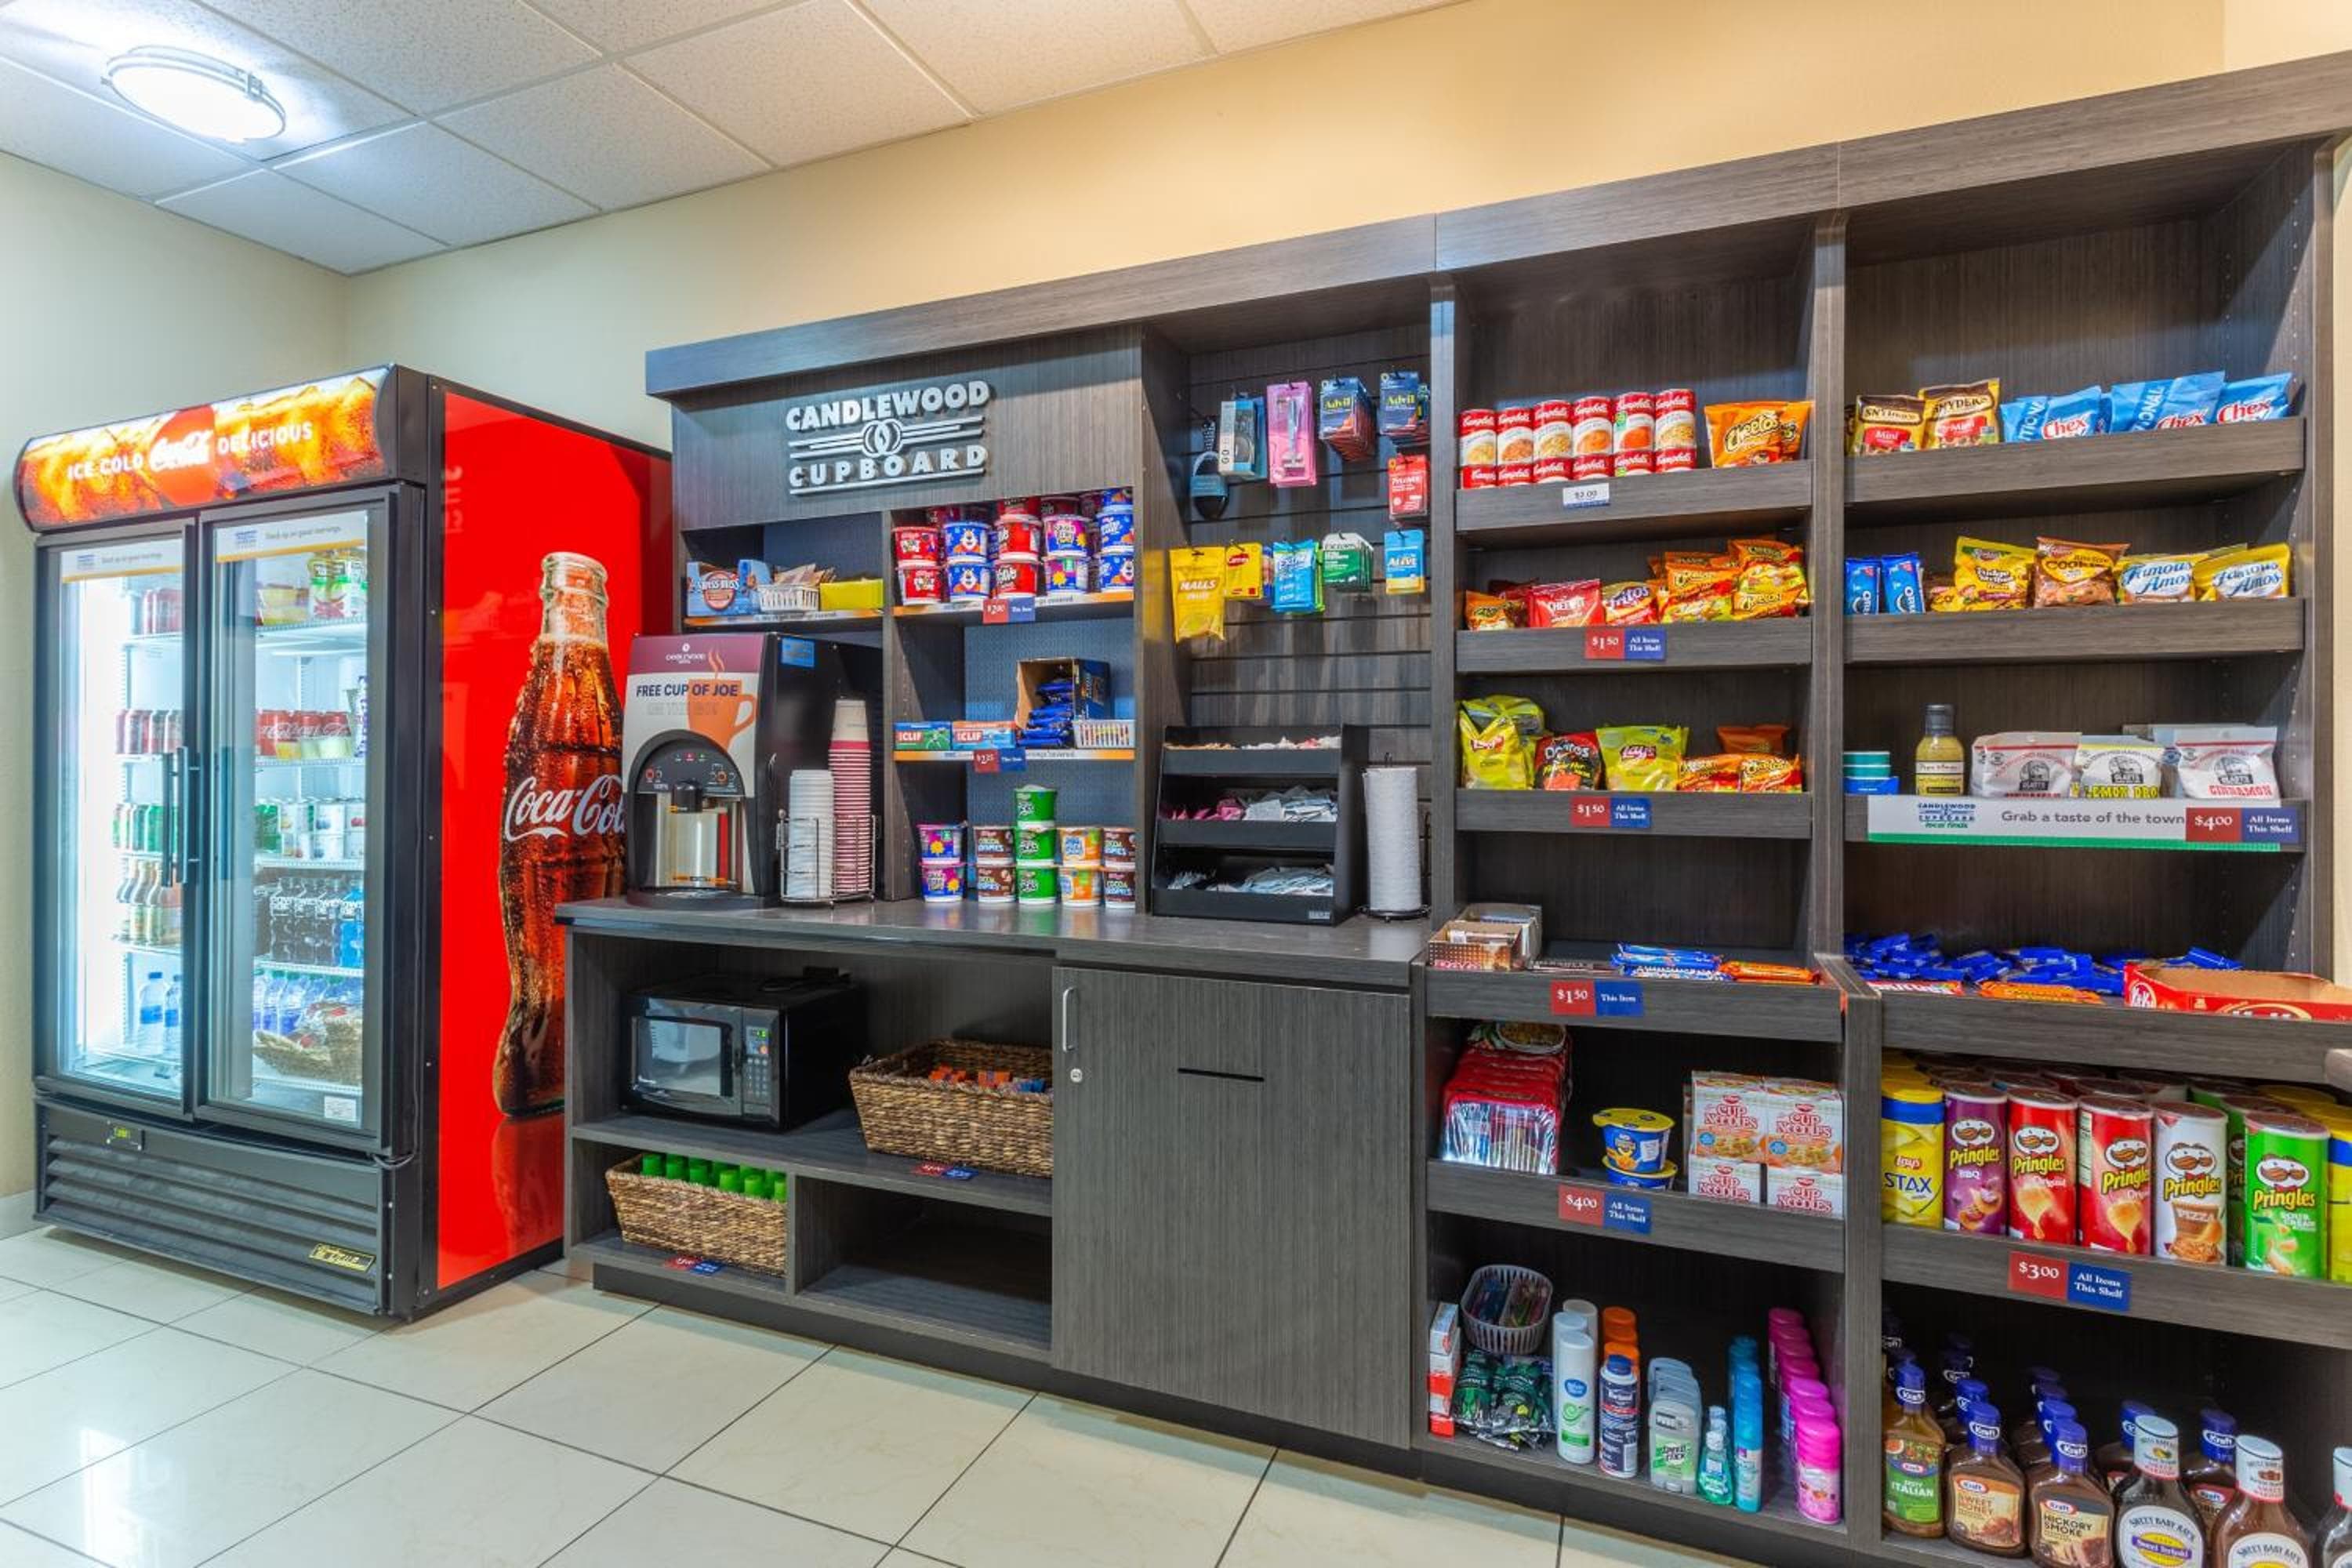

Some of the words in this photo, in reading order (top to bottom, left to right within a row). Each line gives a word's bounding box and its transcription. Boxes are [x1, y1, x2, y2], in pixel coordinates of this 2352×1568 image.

[786, 380, 990, 431] CANDLEWOOD
[1325, 397, 1352, 410] Advil
[1386, 394, 1415, 406] Advil
[2218, 400, 2271, 425] Chex
[2042, 415, 2088, 440] Chex
[2157, 412, 2203, 429] Chex
[1725, 410, 1780, 452] Cheetos
[67, 461, 100, 481] ICE
[100, 454, 143, 477] COLD
[216, 420, 314, 456] DELICIOUS
[789, 445, 989, 488] CUPBOARD
[2122, 562, 2192, 586] Famous
[1180, 579, 1216, 590] HALLS
[2133, 572, 2194, 595] Amos
[2226, 573, 2285, 597] Amos
[636, 684, 662, 698] FREE
[664, 683, 689, 697] CUP
[690, 684, 710, 696] OF
[713, 684, 739, 697] JOE
[903, 731, 922, 742] CLIF
[960, 731, 982, 742] CLIF
[2084, 786, 2129, 799] LEMON
[2208, 785, 2273, 797] CINNAMON
[504, 774, 626, 842] Coca-Col
[2001, 810, 2038, 822] Grab
[2041, 813, 2051, 822] a
[2054, 811, 2091, 823] taste
[2096, 811, 2113, 823] of
[2116, 811, 2141, 824] the
[2146, 813, 2185, 825] town
[2249, 815, 2264, 823] All
[2266, 815, 2290, 824] Items
[2246, 825, 2267, 833] This
[2269, 825, 2292, 834] Shelf
[1601, 993, 1617, 1002] This
[1619, 994, 1637, 1003] Item
[1716, 1103, 1747, 1117] CUP
[1704, 1111, 1759, 1130] NOODLES
[1788, 1112, 1822, 1126] CUP
[1776, 1120, 1832, 1138] NOODLES
[1949, 1145, 2000, 1170] Pringles
[2013, 1154, 2066, 1179] Pringles
[1708, 1175, 1740, 1188] CUP
[1884, 1172, 1933, 1194] STAX
[2163, 1175, 2223, 1201] Pringles
[1697, 1181, 1751, 1201] NOODLES
[1791, 1186, 1822, 1200] CUP
[1611, 1201, 1622, 1210] All
[1776, 1193, 1832, 1213] NOODLES
[2252, 1189, 2316, 1210] Pringles
[1609, 1210, 1625, 1221] This
[1627, 1211, 1646, 1223] Shelf
[2077, 1272, 2093, 1282] All
[2095, 1276, 2122, 1287] Items
[2074, 1281, 2096, 1294] This
[2098, 1285, 2124, 1298] Shelf
[1902, 1389, 1923, 1403] Kraft
[1974, 1425, 1998, 1439] Kraft
[2209, 1434, 2233, 1446] Kraft
[2063, 1444, 2085, 1457] Kraft
[1890, 1482, 1934, 1497] ITALIAN
[2042, 1514, 2093, 1532] HICKORY
[2043, 1523, 2082, 1537] SMOKE
[2129, 1517, 2154, 1527] SWEET
[2155, 1517, 2176, 1530] BABY
[2237, 1545, 2261, 1557] SWEET
[2263, 1544, 2282, 1556] BABY
